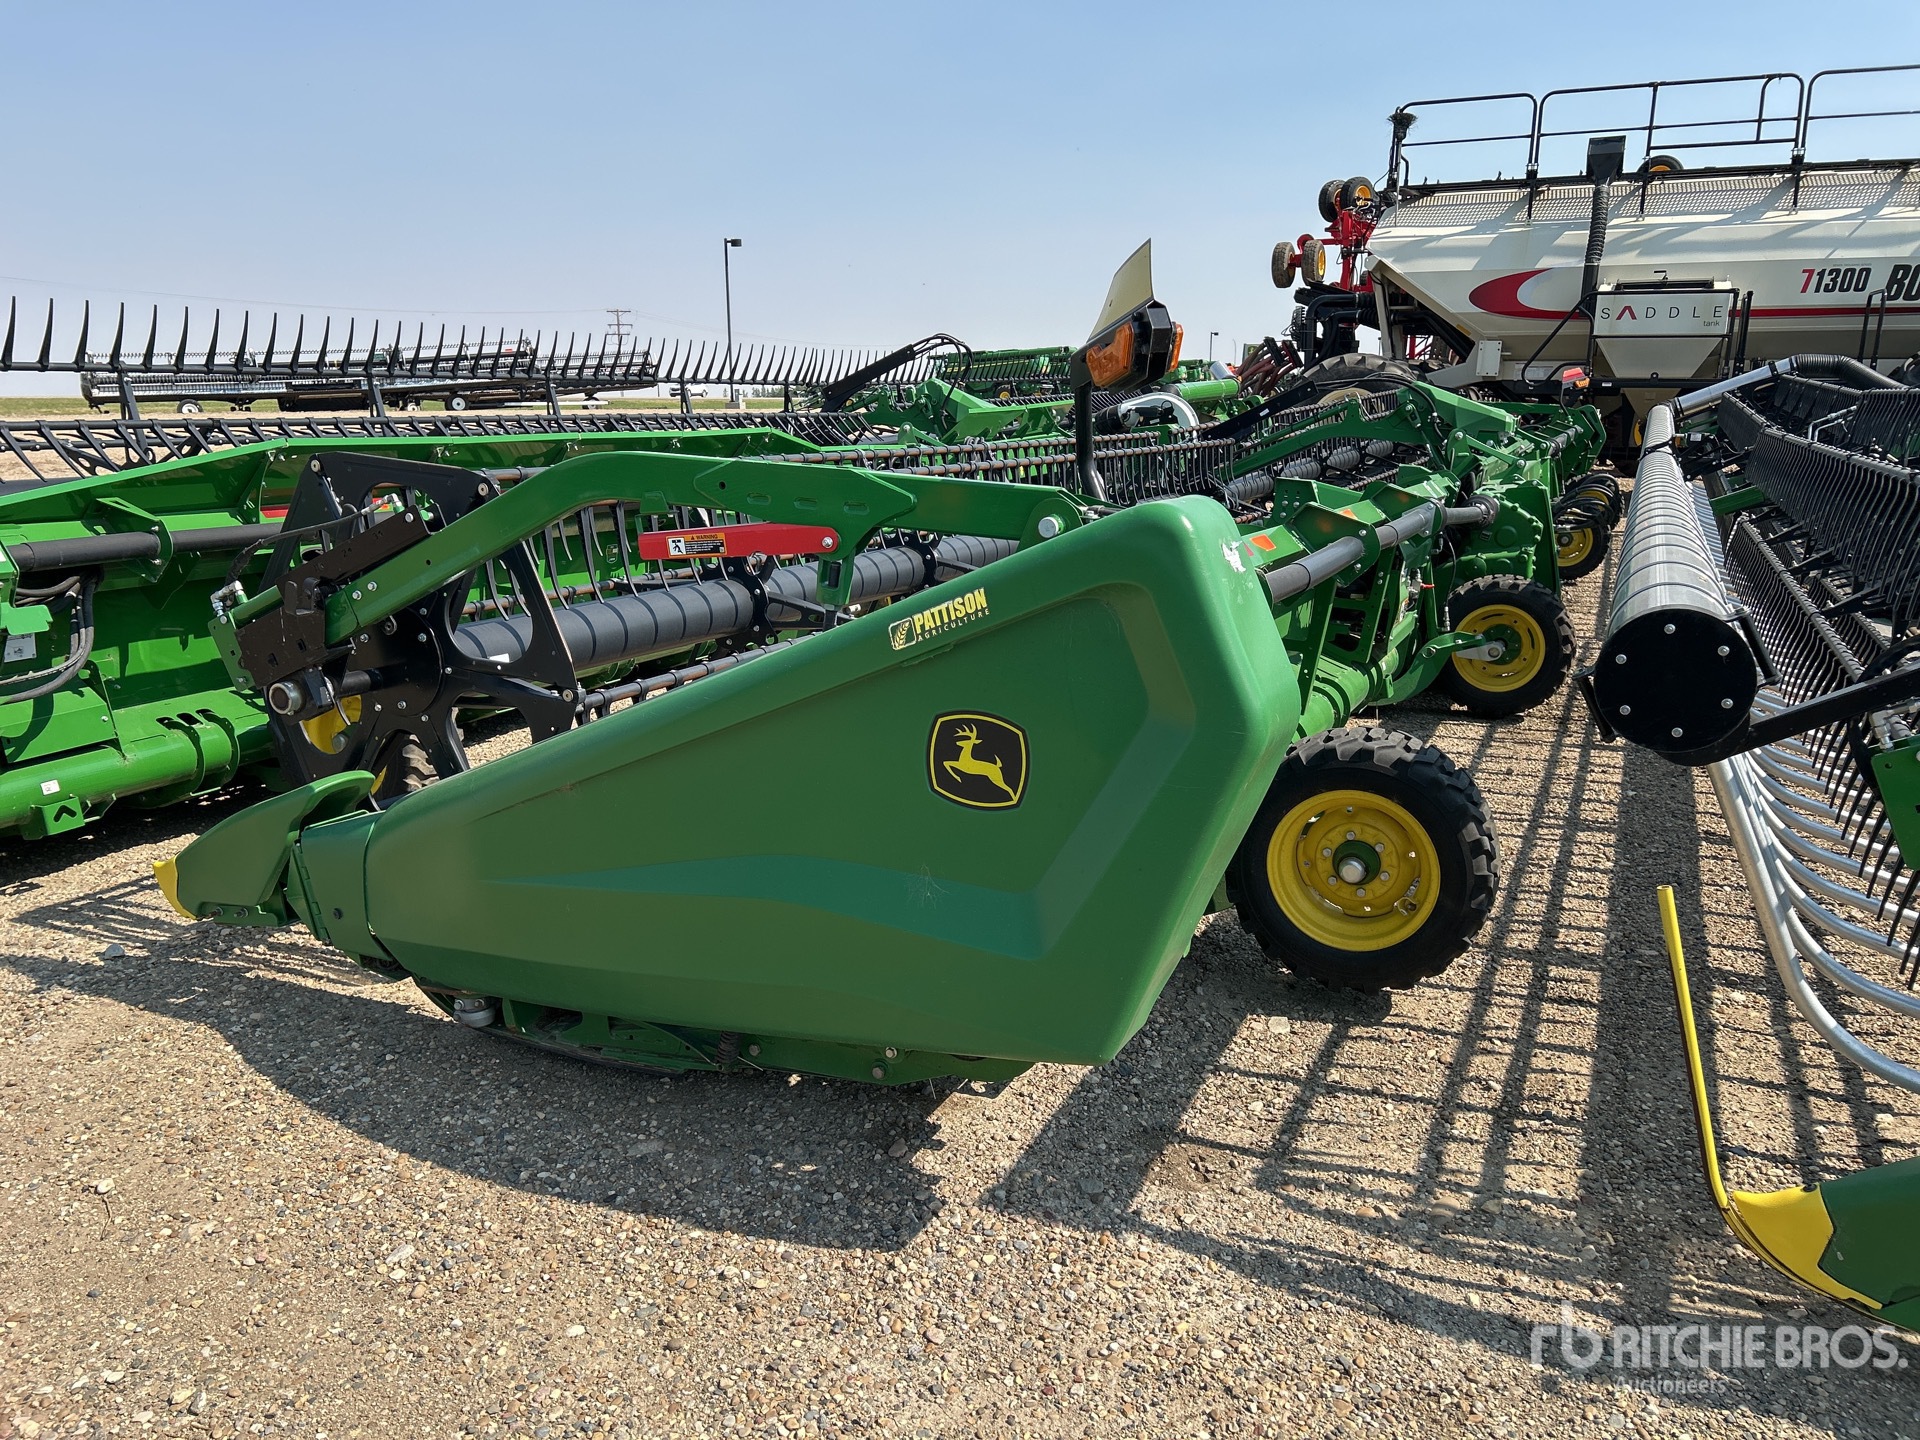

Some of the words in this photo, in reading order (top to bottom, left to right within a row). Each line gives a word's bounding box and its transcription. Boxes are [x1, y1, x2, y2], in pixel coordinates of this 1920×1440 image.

[1800, 267, 1872, 293] 71300
[1600, 305, 1724, 320] SADDLE
[912, 587, 988, 634] PATTISON
[917, 608, 990, 642] AGRICULTURE
